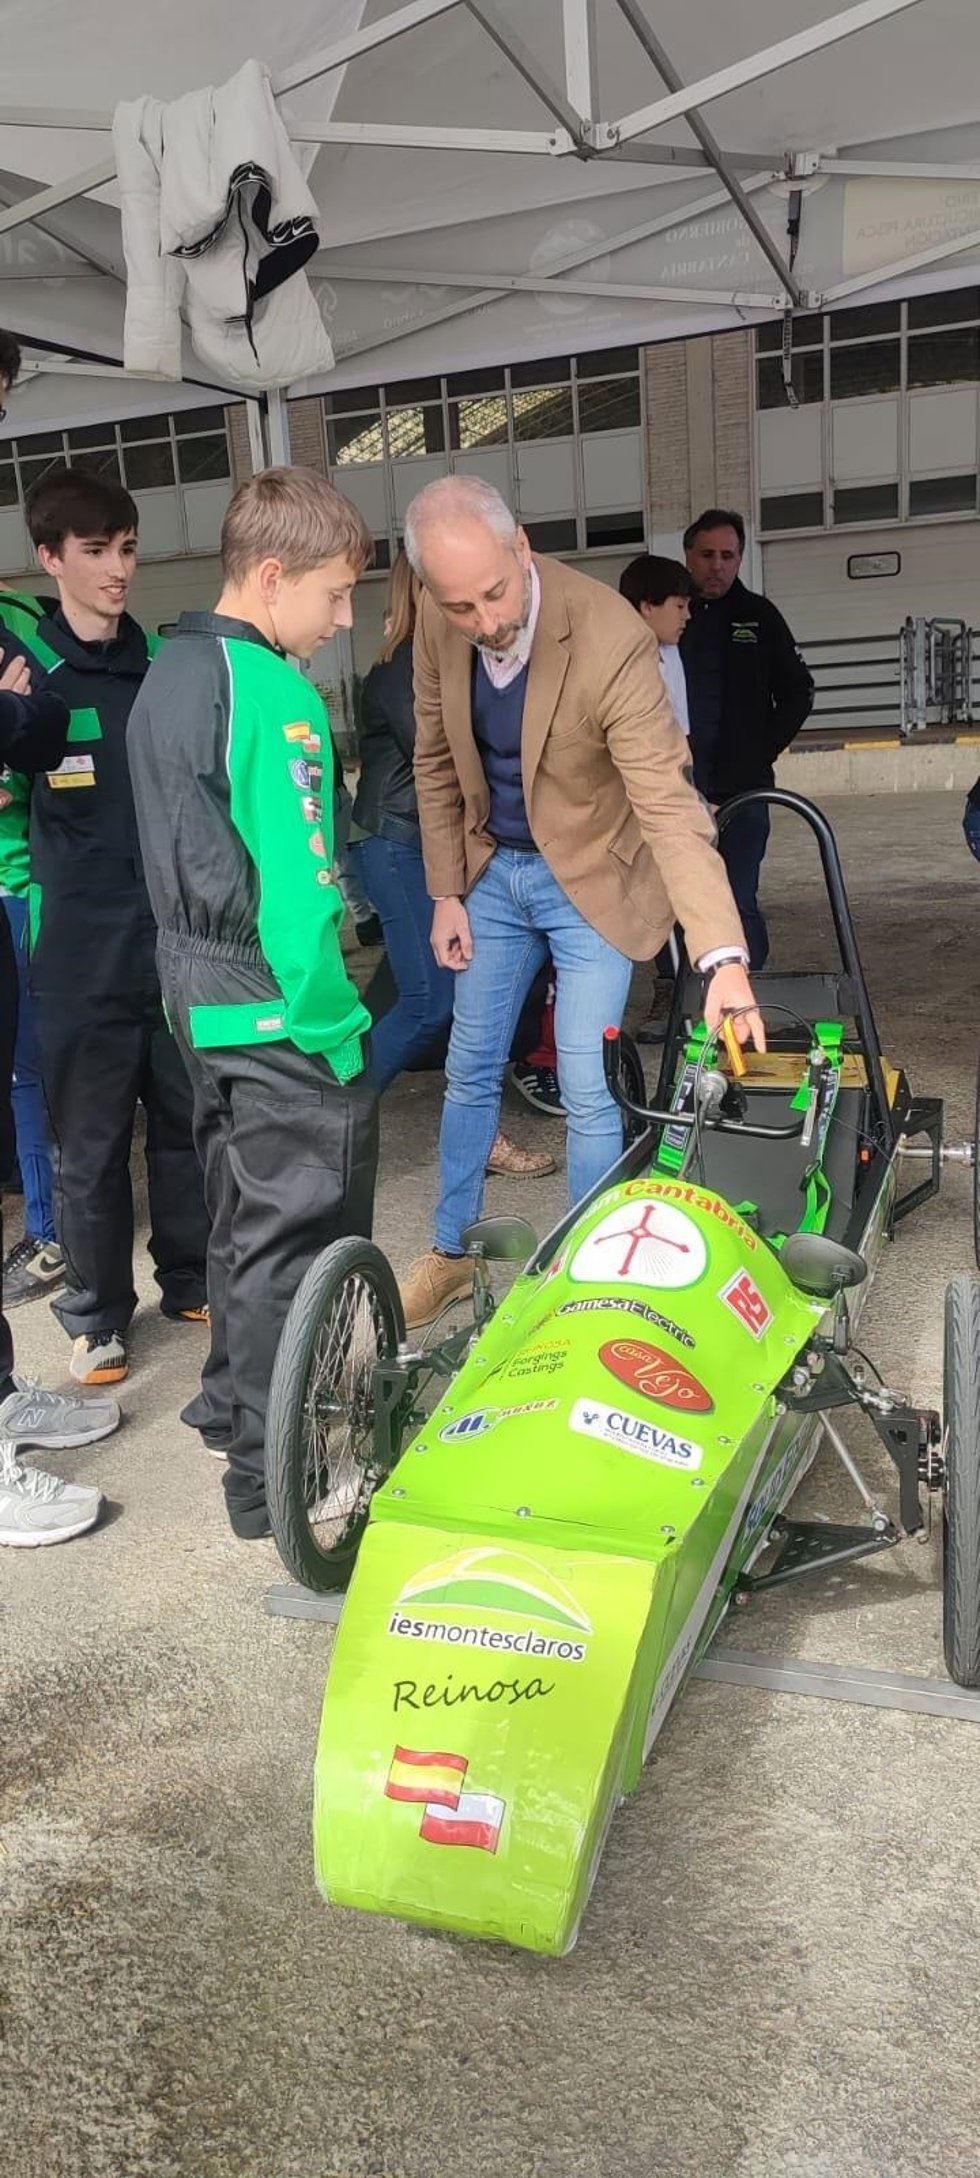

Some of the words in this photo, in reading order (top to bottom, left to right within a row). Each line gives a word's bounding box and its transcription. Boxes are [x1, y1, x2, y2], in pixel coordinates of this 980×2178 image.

[624, 1180, 758, 1251] Cantabria
[508, 1361, 564, 1378] Castings
[511, 1350, 568, 1367] Forgings
[610, 1342, 655, 1364] Casa
[606, 1412, 693, 1459] CUEVAS
[389, 1612, 585, 1661] iesmontesclaros
[393, 1674, 556, 1712] Reinosa
